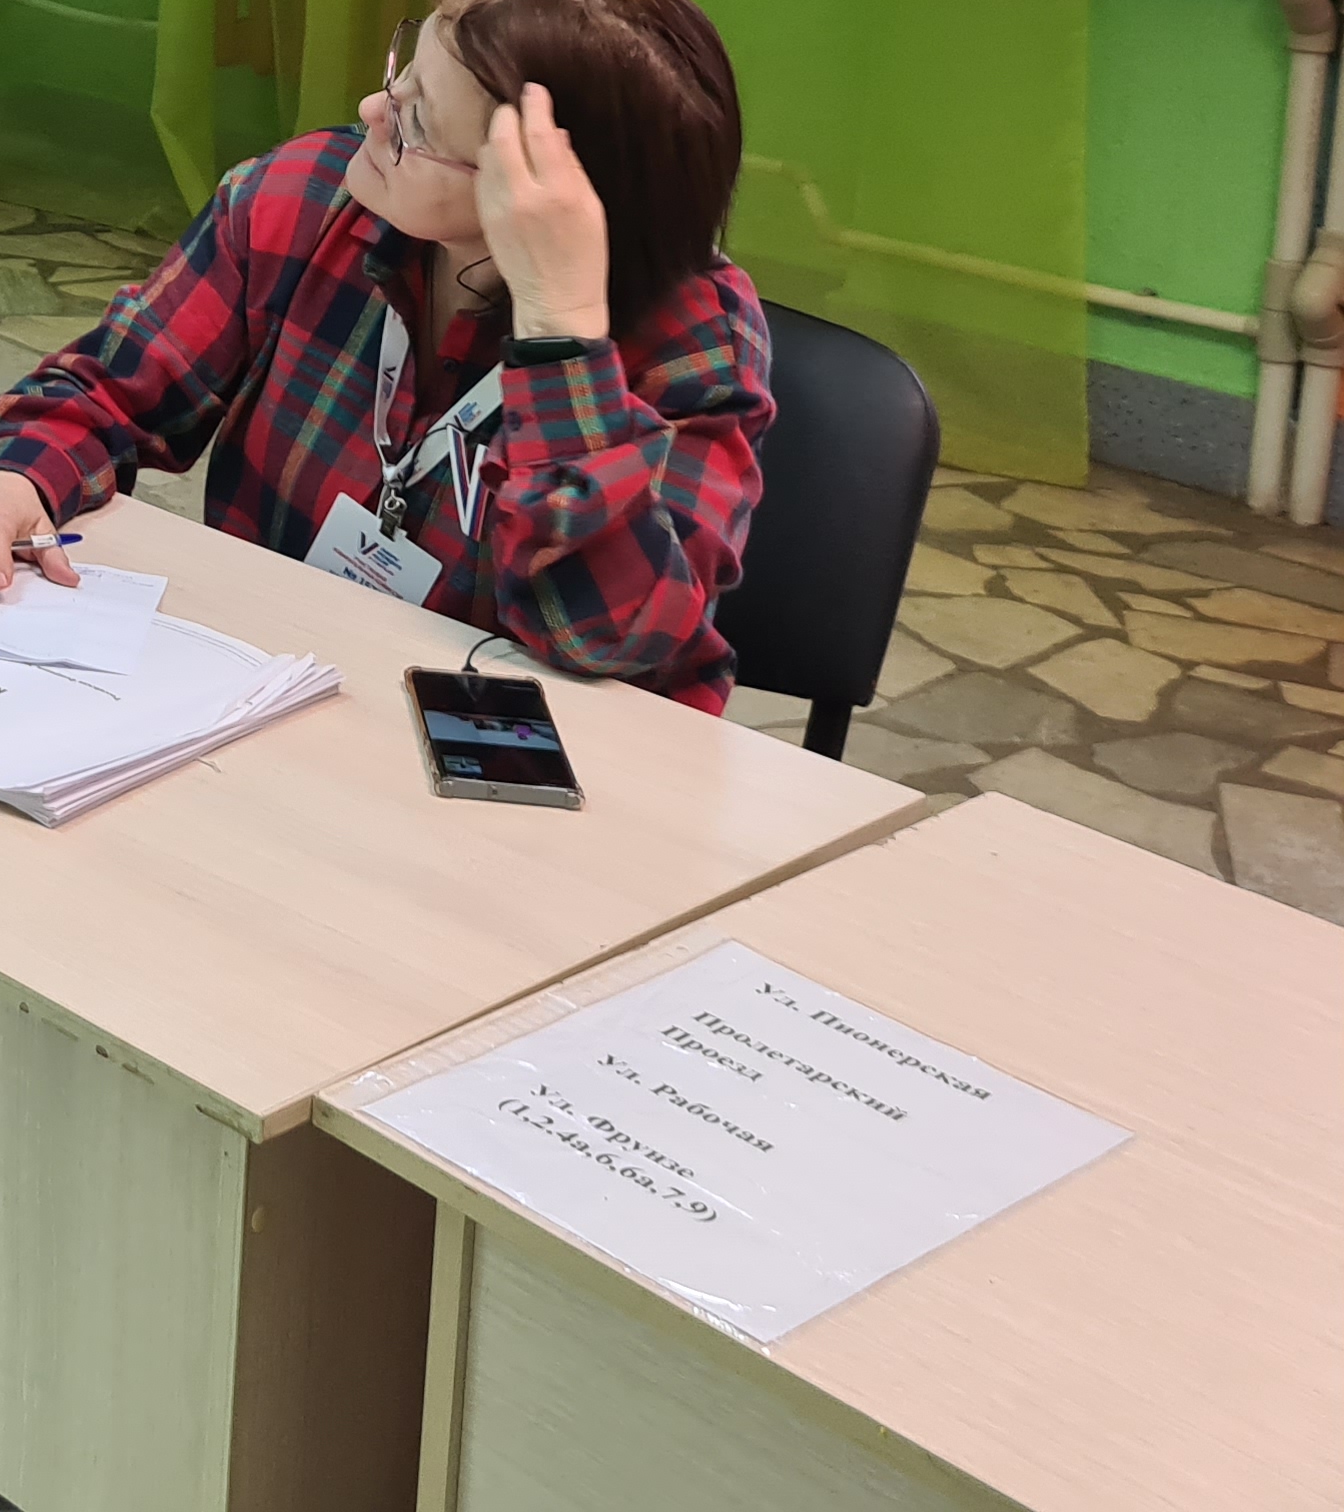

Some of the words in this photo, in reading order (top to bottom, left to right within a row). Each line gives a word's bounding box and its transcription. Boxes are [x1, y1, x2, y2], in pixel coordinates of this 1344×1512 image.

[660, 1024, 764, 1083] Проезд
[691, 1010, 909, 1122] Пролетарский
[755, 981, 800, 1012] Ул.
[809, 1009, 992, 1101] Пионерская
[530, 1083, 575, 1116] Ул.
[586, 1115, 695, 1180] Фрунзе
[597, 1054, 642, 1085] Ул.
[649, 1082, 775, 1153] Рабочая
